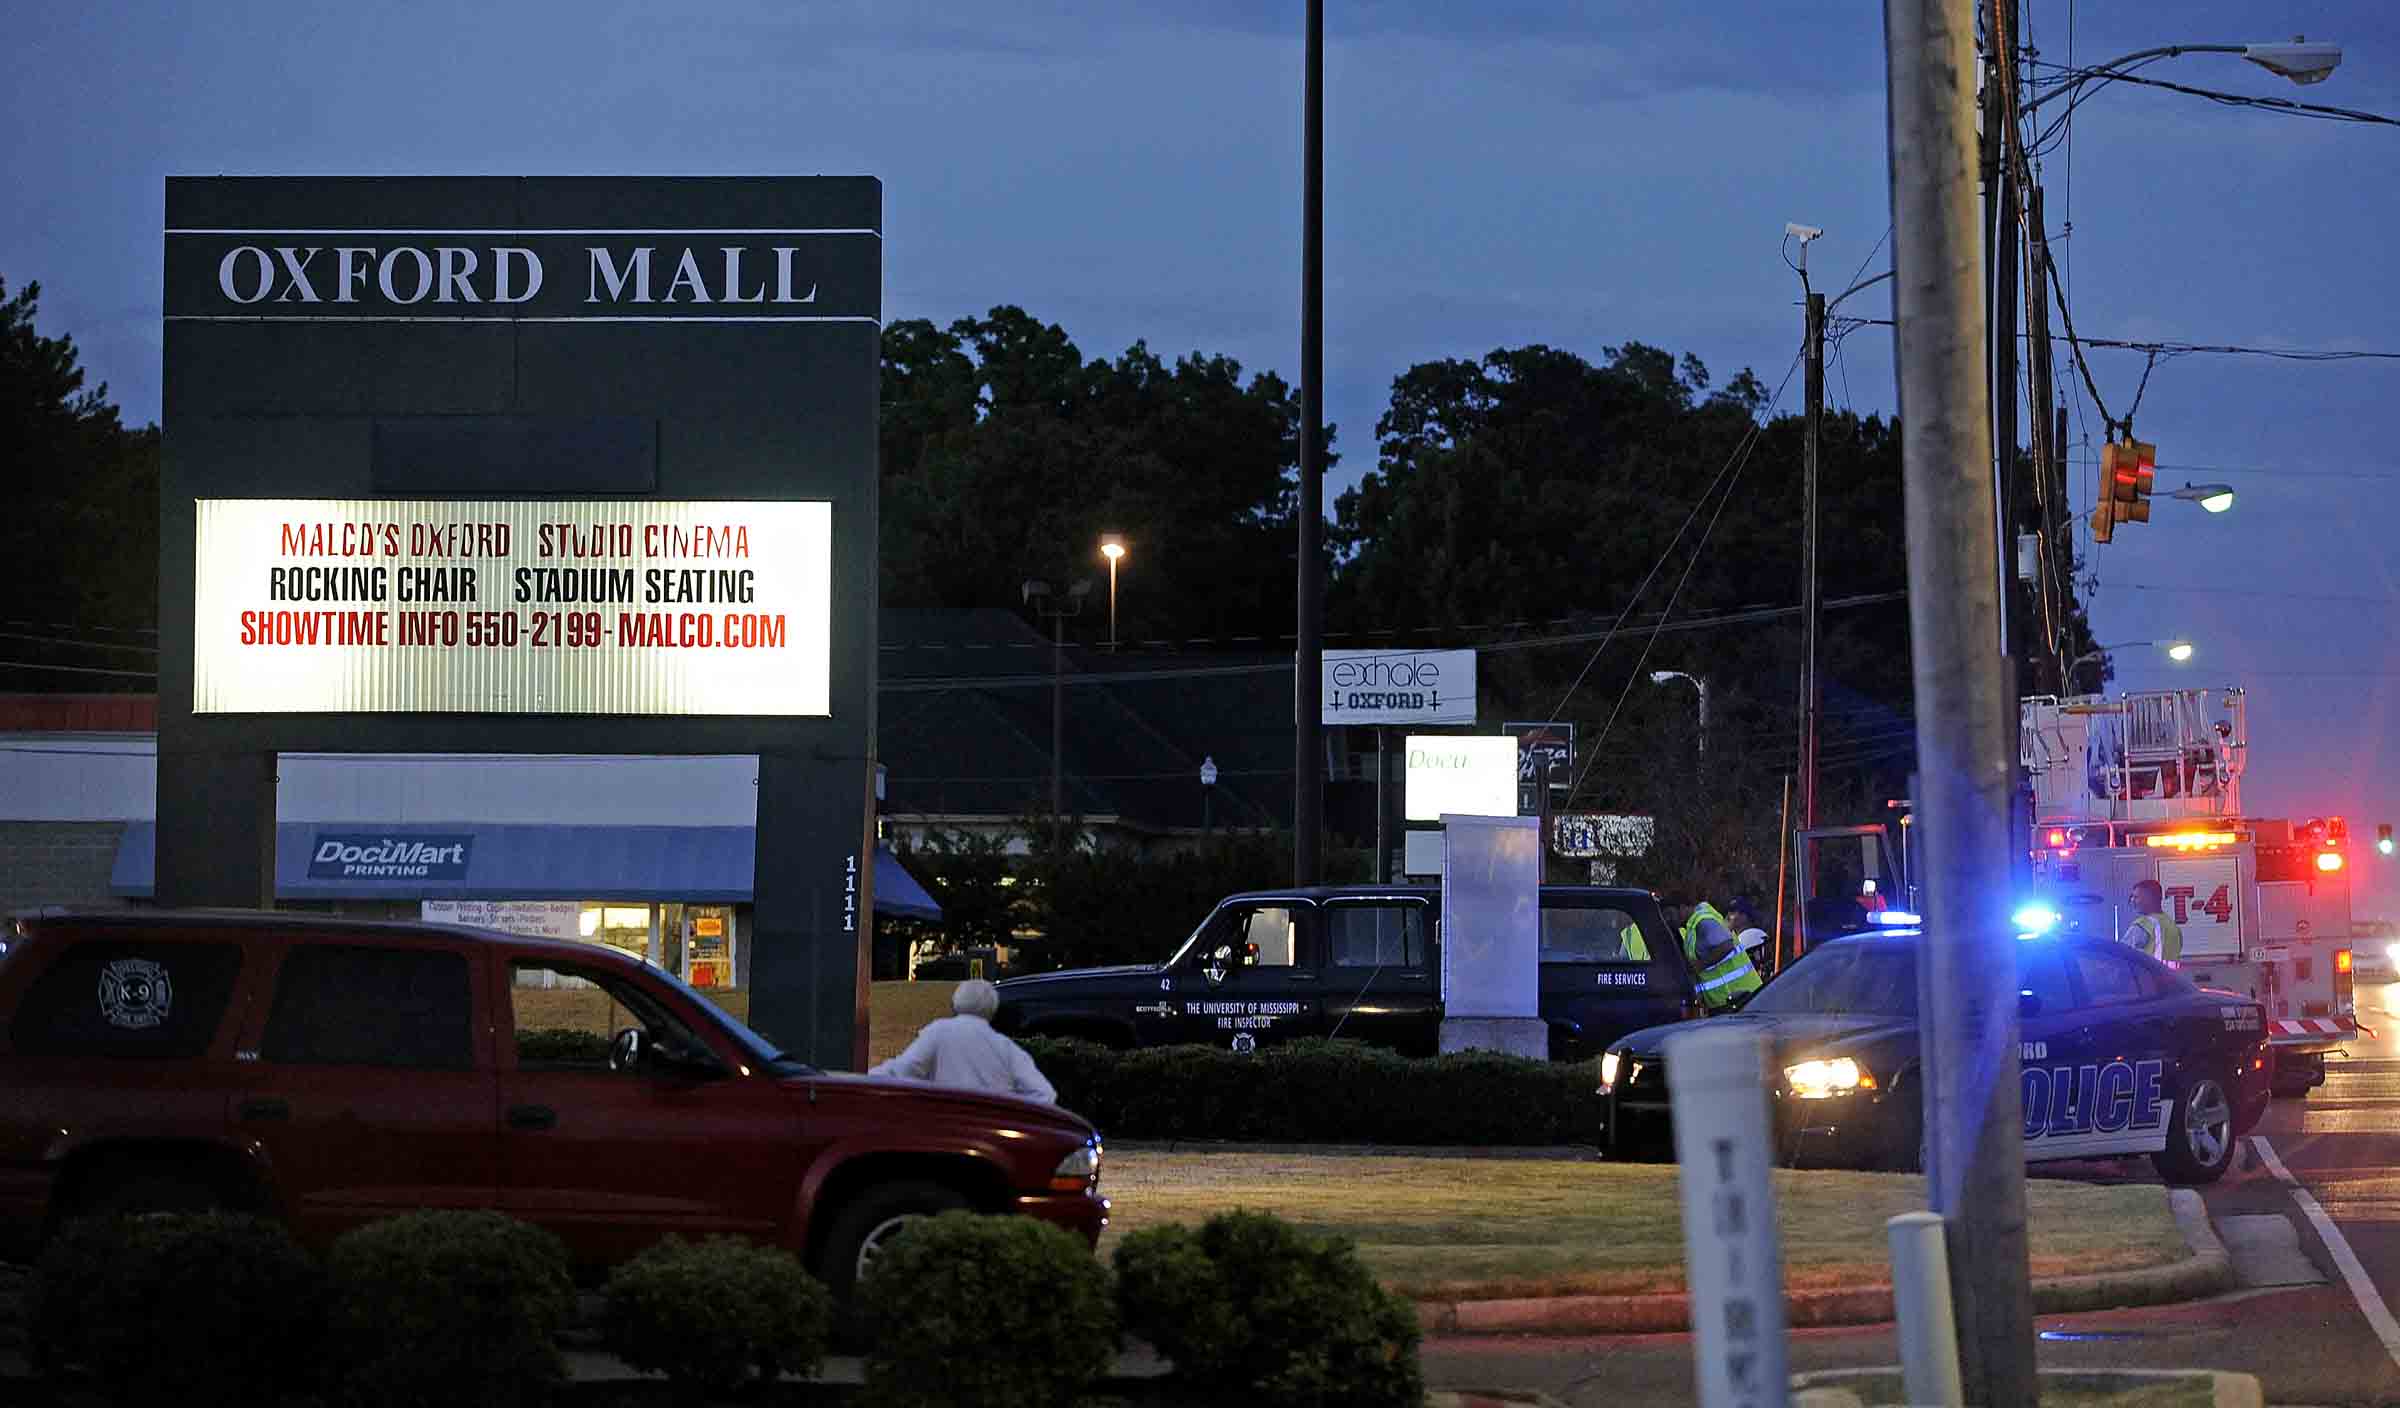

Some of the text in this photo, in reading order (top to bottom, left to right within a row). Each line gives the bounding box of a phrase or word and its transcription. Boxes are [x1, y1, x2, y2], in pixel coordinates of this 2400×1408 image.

[218, 246, 816, 303] OXFORD MALL
[281, 523, 749, 558] MALCO'S OXFORD STUDIO CINEMA
[270, 567, 754, 604] ROCKING CHAIR STADIUM SEATING
[240, 611, 389, 647] SHOWTIME
[398, 611, 458, 647] INFO
[1333, 656, 1440, 687] exhale
[1348, 692, 1425, 710] OXFORD
[314, 838, 465, 864] DocuMart
[343, 864, 429, 876] PRINTING
[2165, 885, 2233, 924] T-4
[1160, 978, 1170, 991] 42
[1597, 973, 1646, 985] FIRE SERVICES
[120, 984, 150, 1001] K-9
[1186, 1002, 1300, 1015] THE UNIVERSITY OF MISSISSIPPI
[1217, 1017, 1271, 1029] FIRE INSPECTOR
[2020, 1060, 2163, 1138] OLICE
